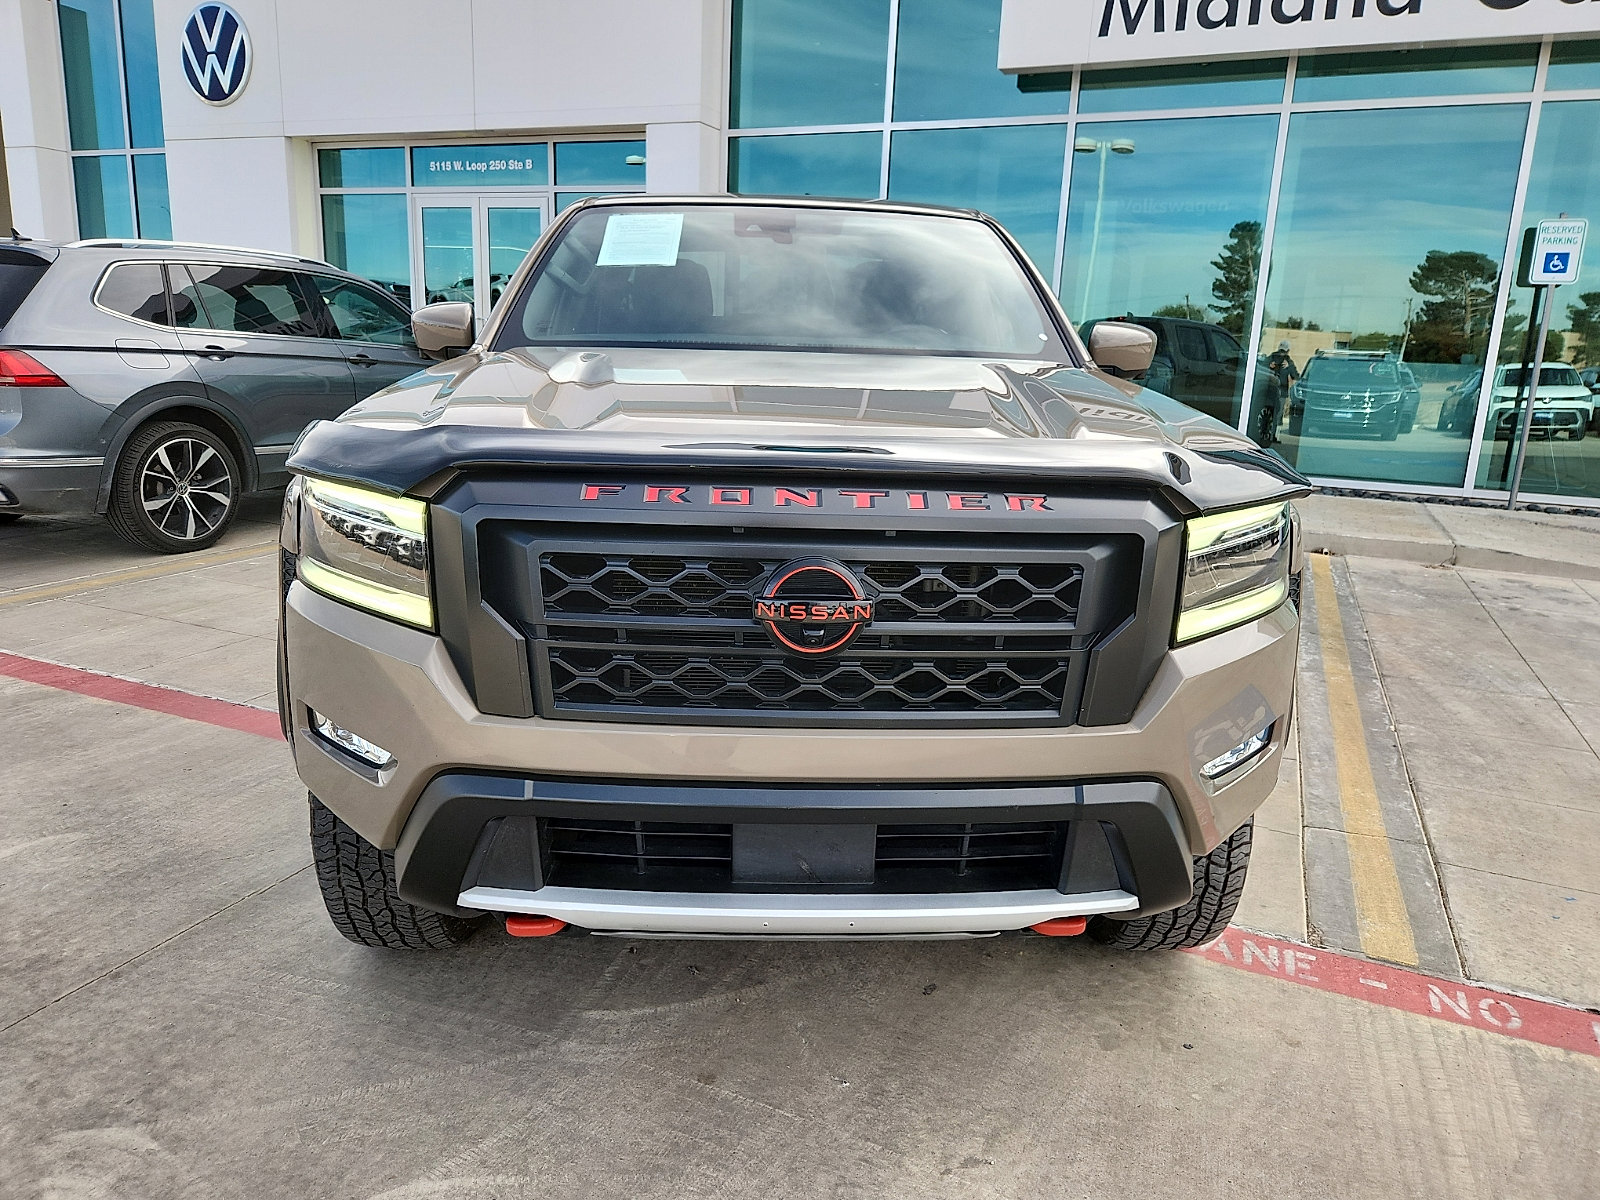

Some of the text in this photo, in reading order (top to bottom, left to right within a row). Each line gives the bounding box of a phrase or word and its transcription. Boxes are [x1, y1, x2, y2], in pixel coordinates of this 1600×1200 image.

[429, 159, 533, 173] 5115 W. Loop 250 Ste B
[1541, 225, 1583, 234] RESERVED
[1542, 236, 1579, 245] PARKING
[580, 482, 1055, 513] FRONTIER
[757, 601, 872, 621] NISSAN
[1199, 939, 1320, 982] ANE
[1427, 983, 1523, 1030] NO
